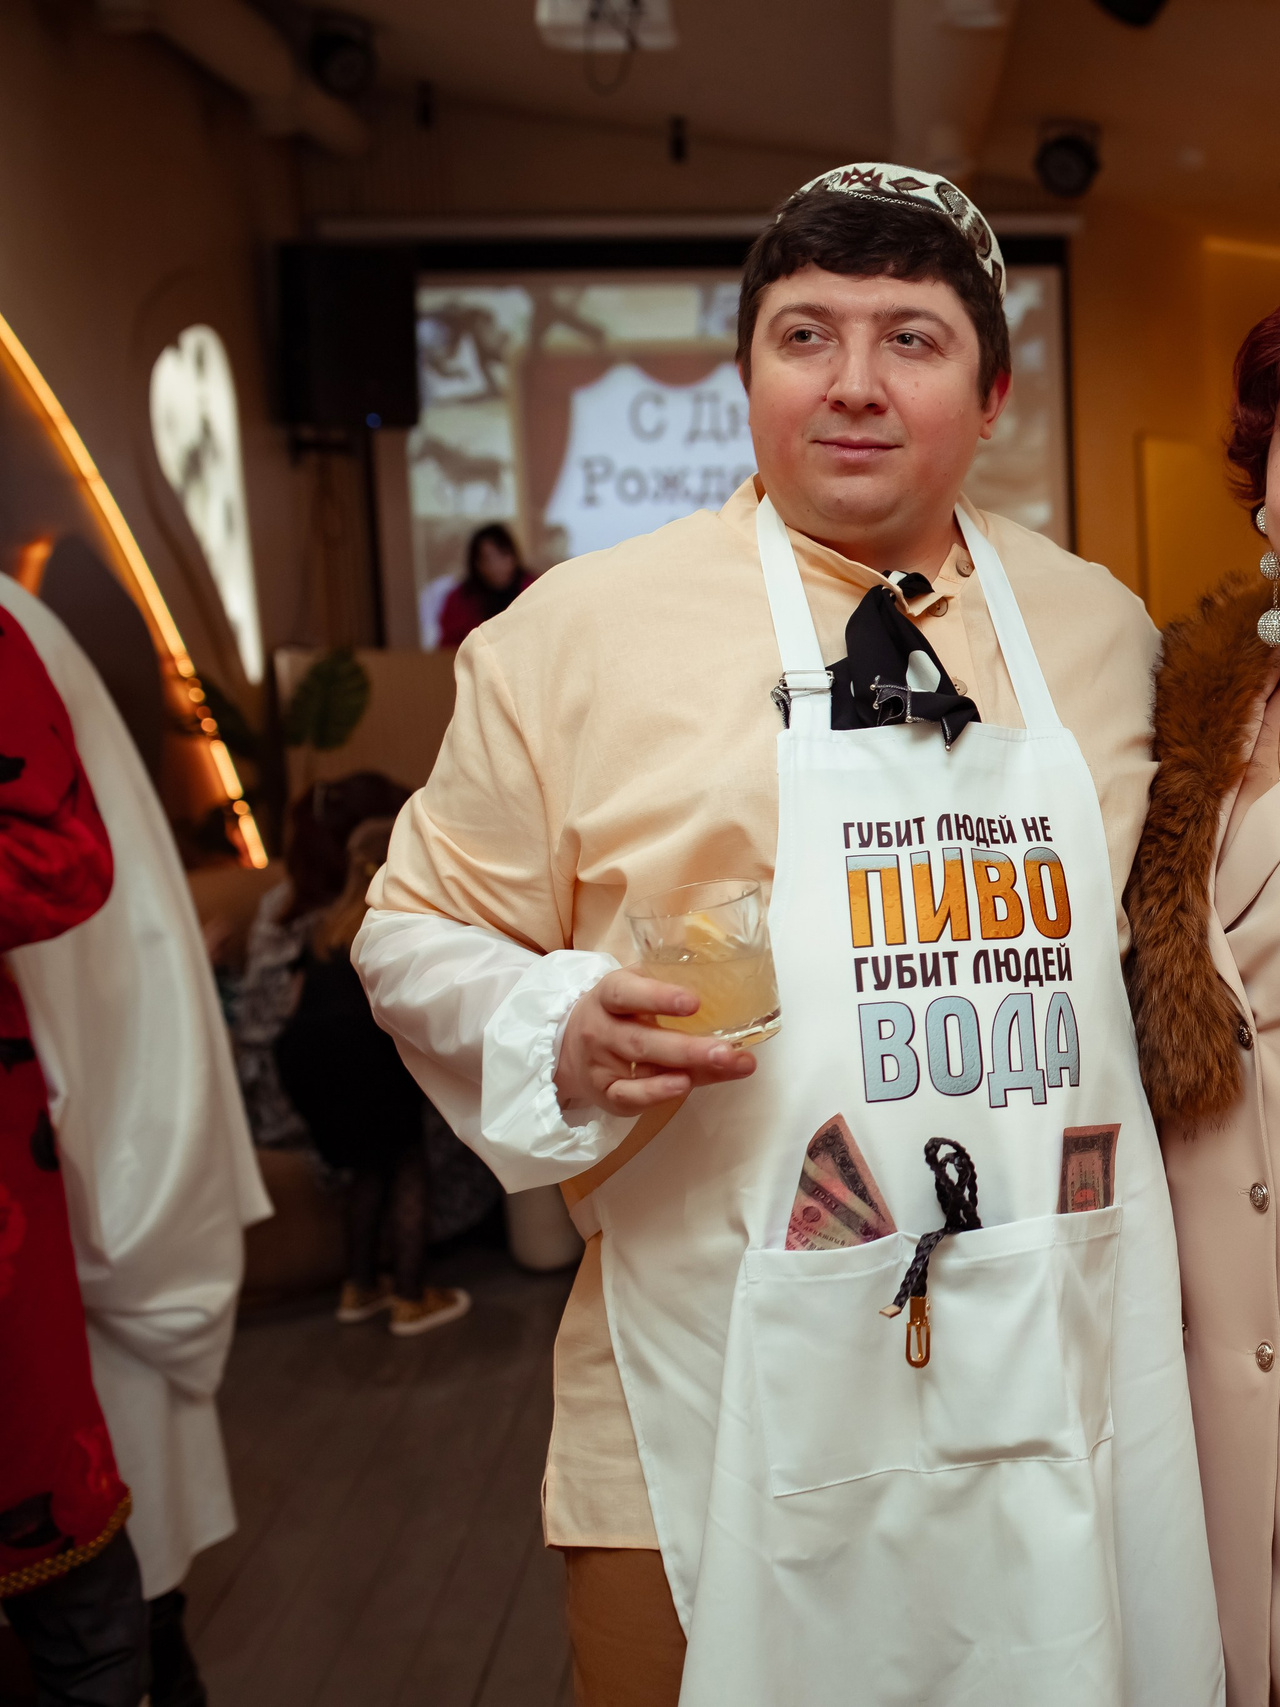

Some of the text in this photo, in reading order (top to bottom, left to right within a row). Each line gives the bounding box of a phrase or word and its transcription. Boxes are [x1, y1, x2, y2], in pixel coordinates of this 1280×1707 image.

[843, 813, 1053, 849] ГУБИТ ЛЮДЕЙ НЕ
[845, 846, 1072, 949] ПИВО
[853, 942, 1073, 993] ГУБИТ ЛЮДЕЙ
[858, 991, 1080, 1109] ВОДА
